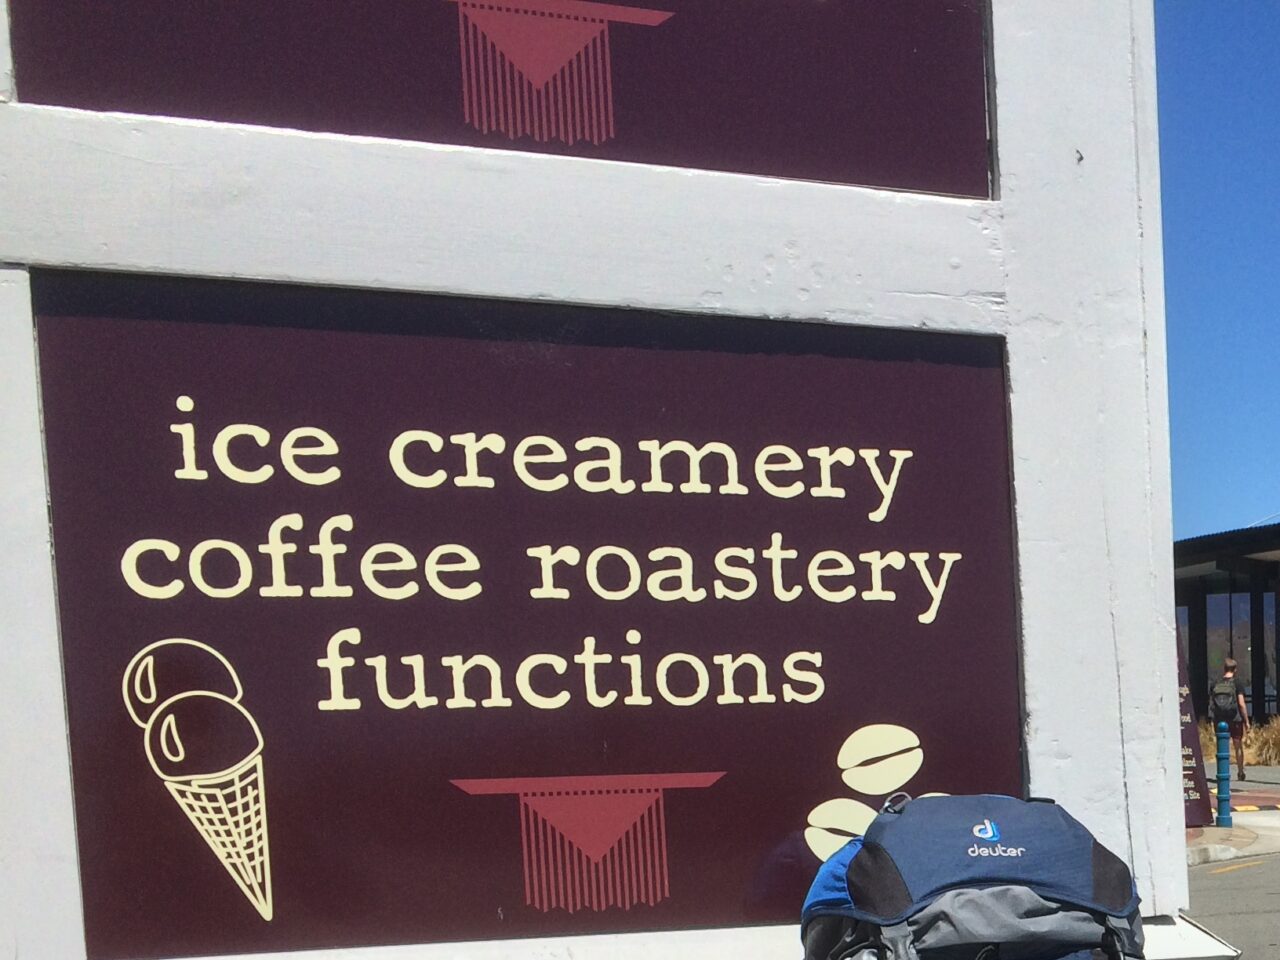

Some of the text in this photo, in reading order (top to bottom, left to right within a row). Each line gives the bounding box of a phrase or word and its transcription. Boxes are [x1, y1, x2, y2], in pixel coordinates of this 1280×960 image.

[170, 396, 913, 522] ice creamery
[121, 513, 962, 624] coffee roastery
[317, 628, 824, 710] functions
[967, 843, 1026, 857] deuter
